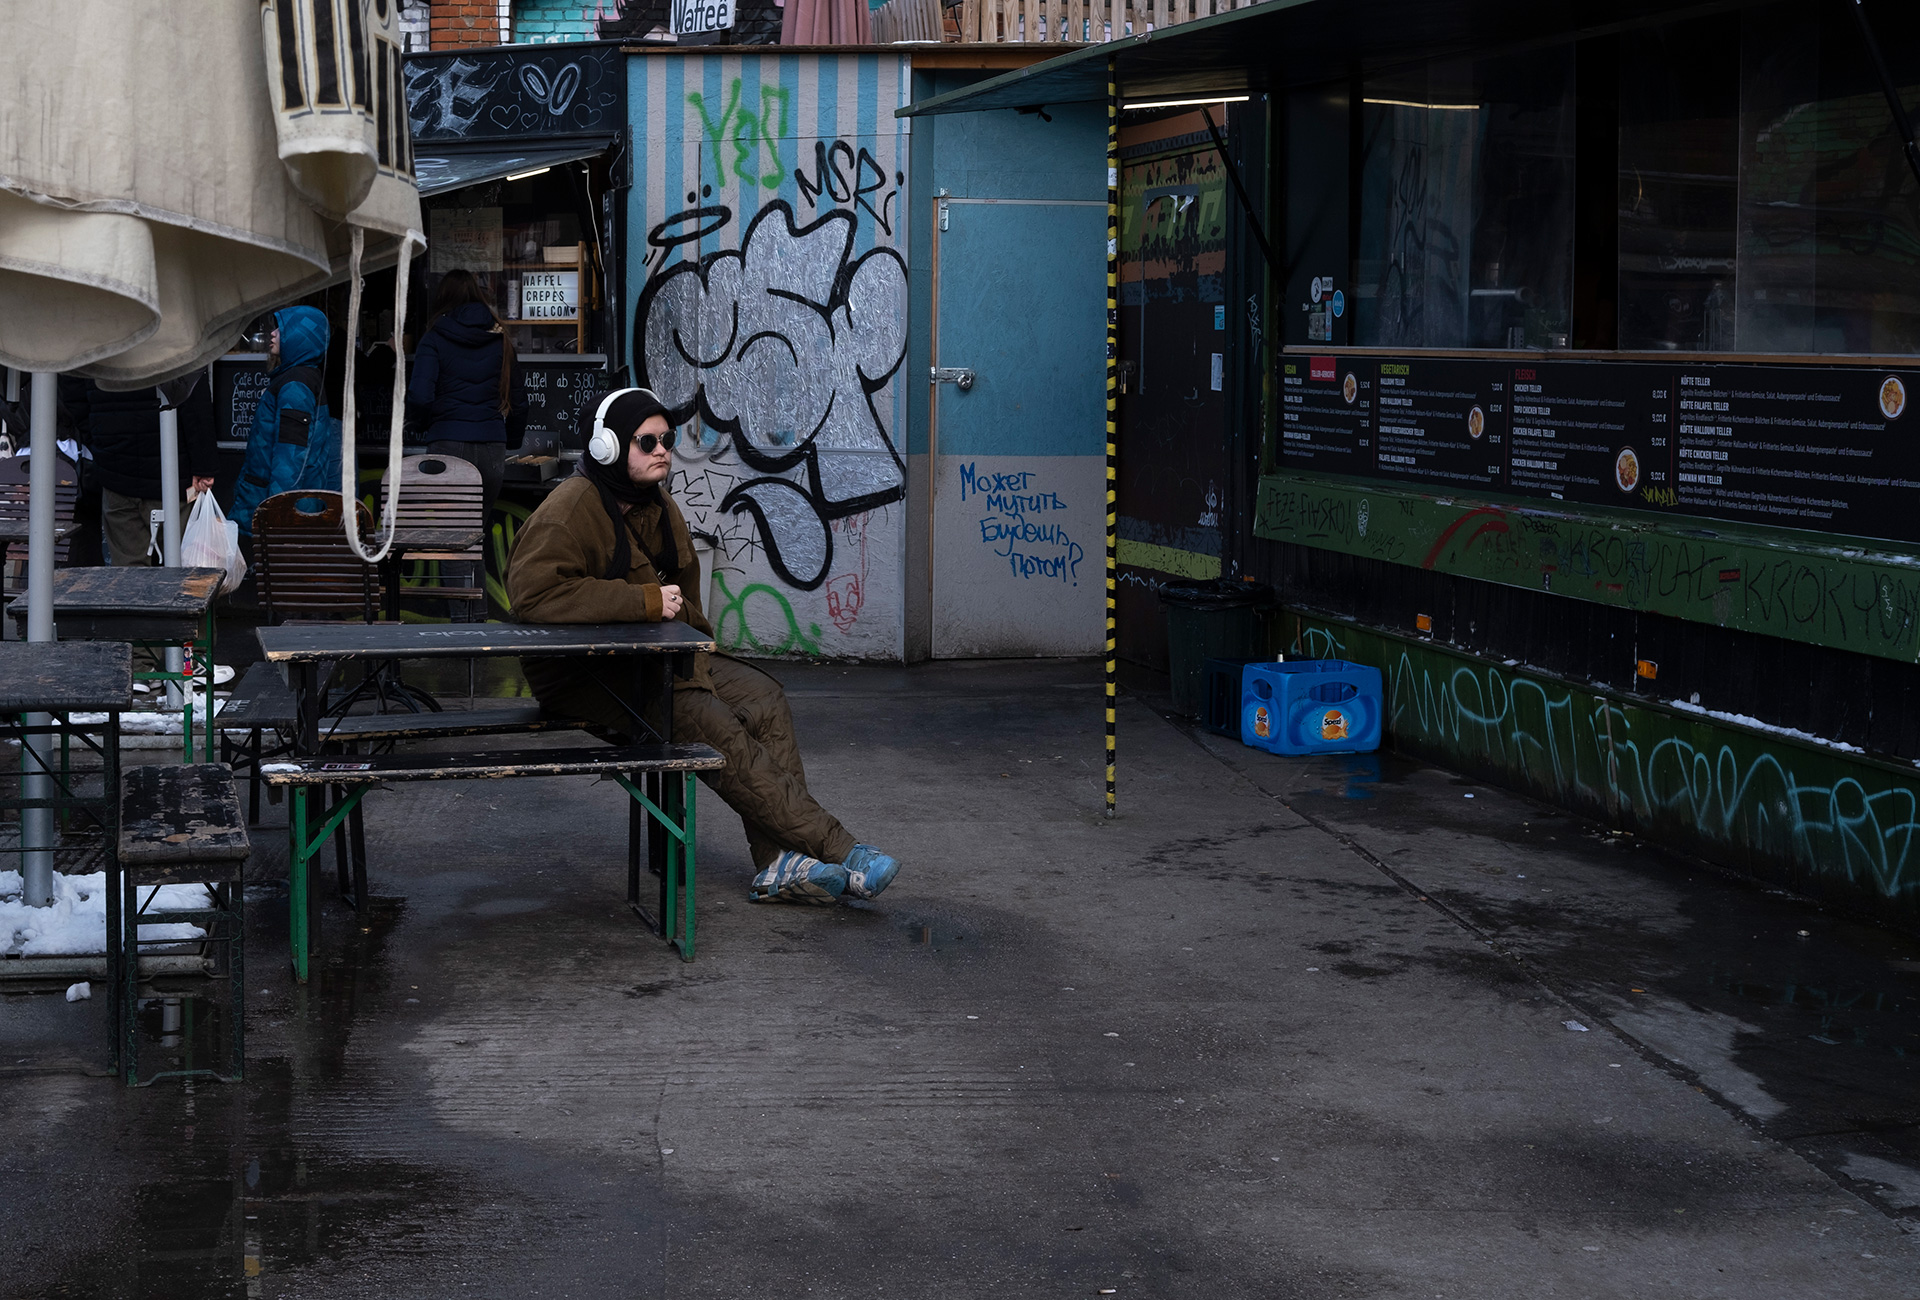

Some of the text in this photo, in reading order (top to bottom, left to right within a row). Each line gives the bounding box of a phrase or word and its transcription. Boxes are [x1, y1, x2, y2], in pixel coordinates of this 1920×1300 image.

[524, 276, 562, 286] WAFFEL
[526, 290, 564, 301] CREPES
[1381, 364, 1410, 375] VEGETARISCH
[1515, 369, 1536, 380] FLEISCH
[233, 372, 270, 388] Café Crè
[556, 373, 568, 388] ab
[573, 373, 594, 391] 3,80
[1695, 377, 1710, 386] TELLER
[1694, 401, 1712, 411] FALAFEL
[1713, 402, 1729, 411] TELLER
[1716, 427, 1732, 436] TELLER
[1713, 451, 1728, 461] TELLER
[960, 462, 1036, 501] Может
[1707, 476, 1722, 485] TELLER
[1324, 718, 1341, 726] Spezi
